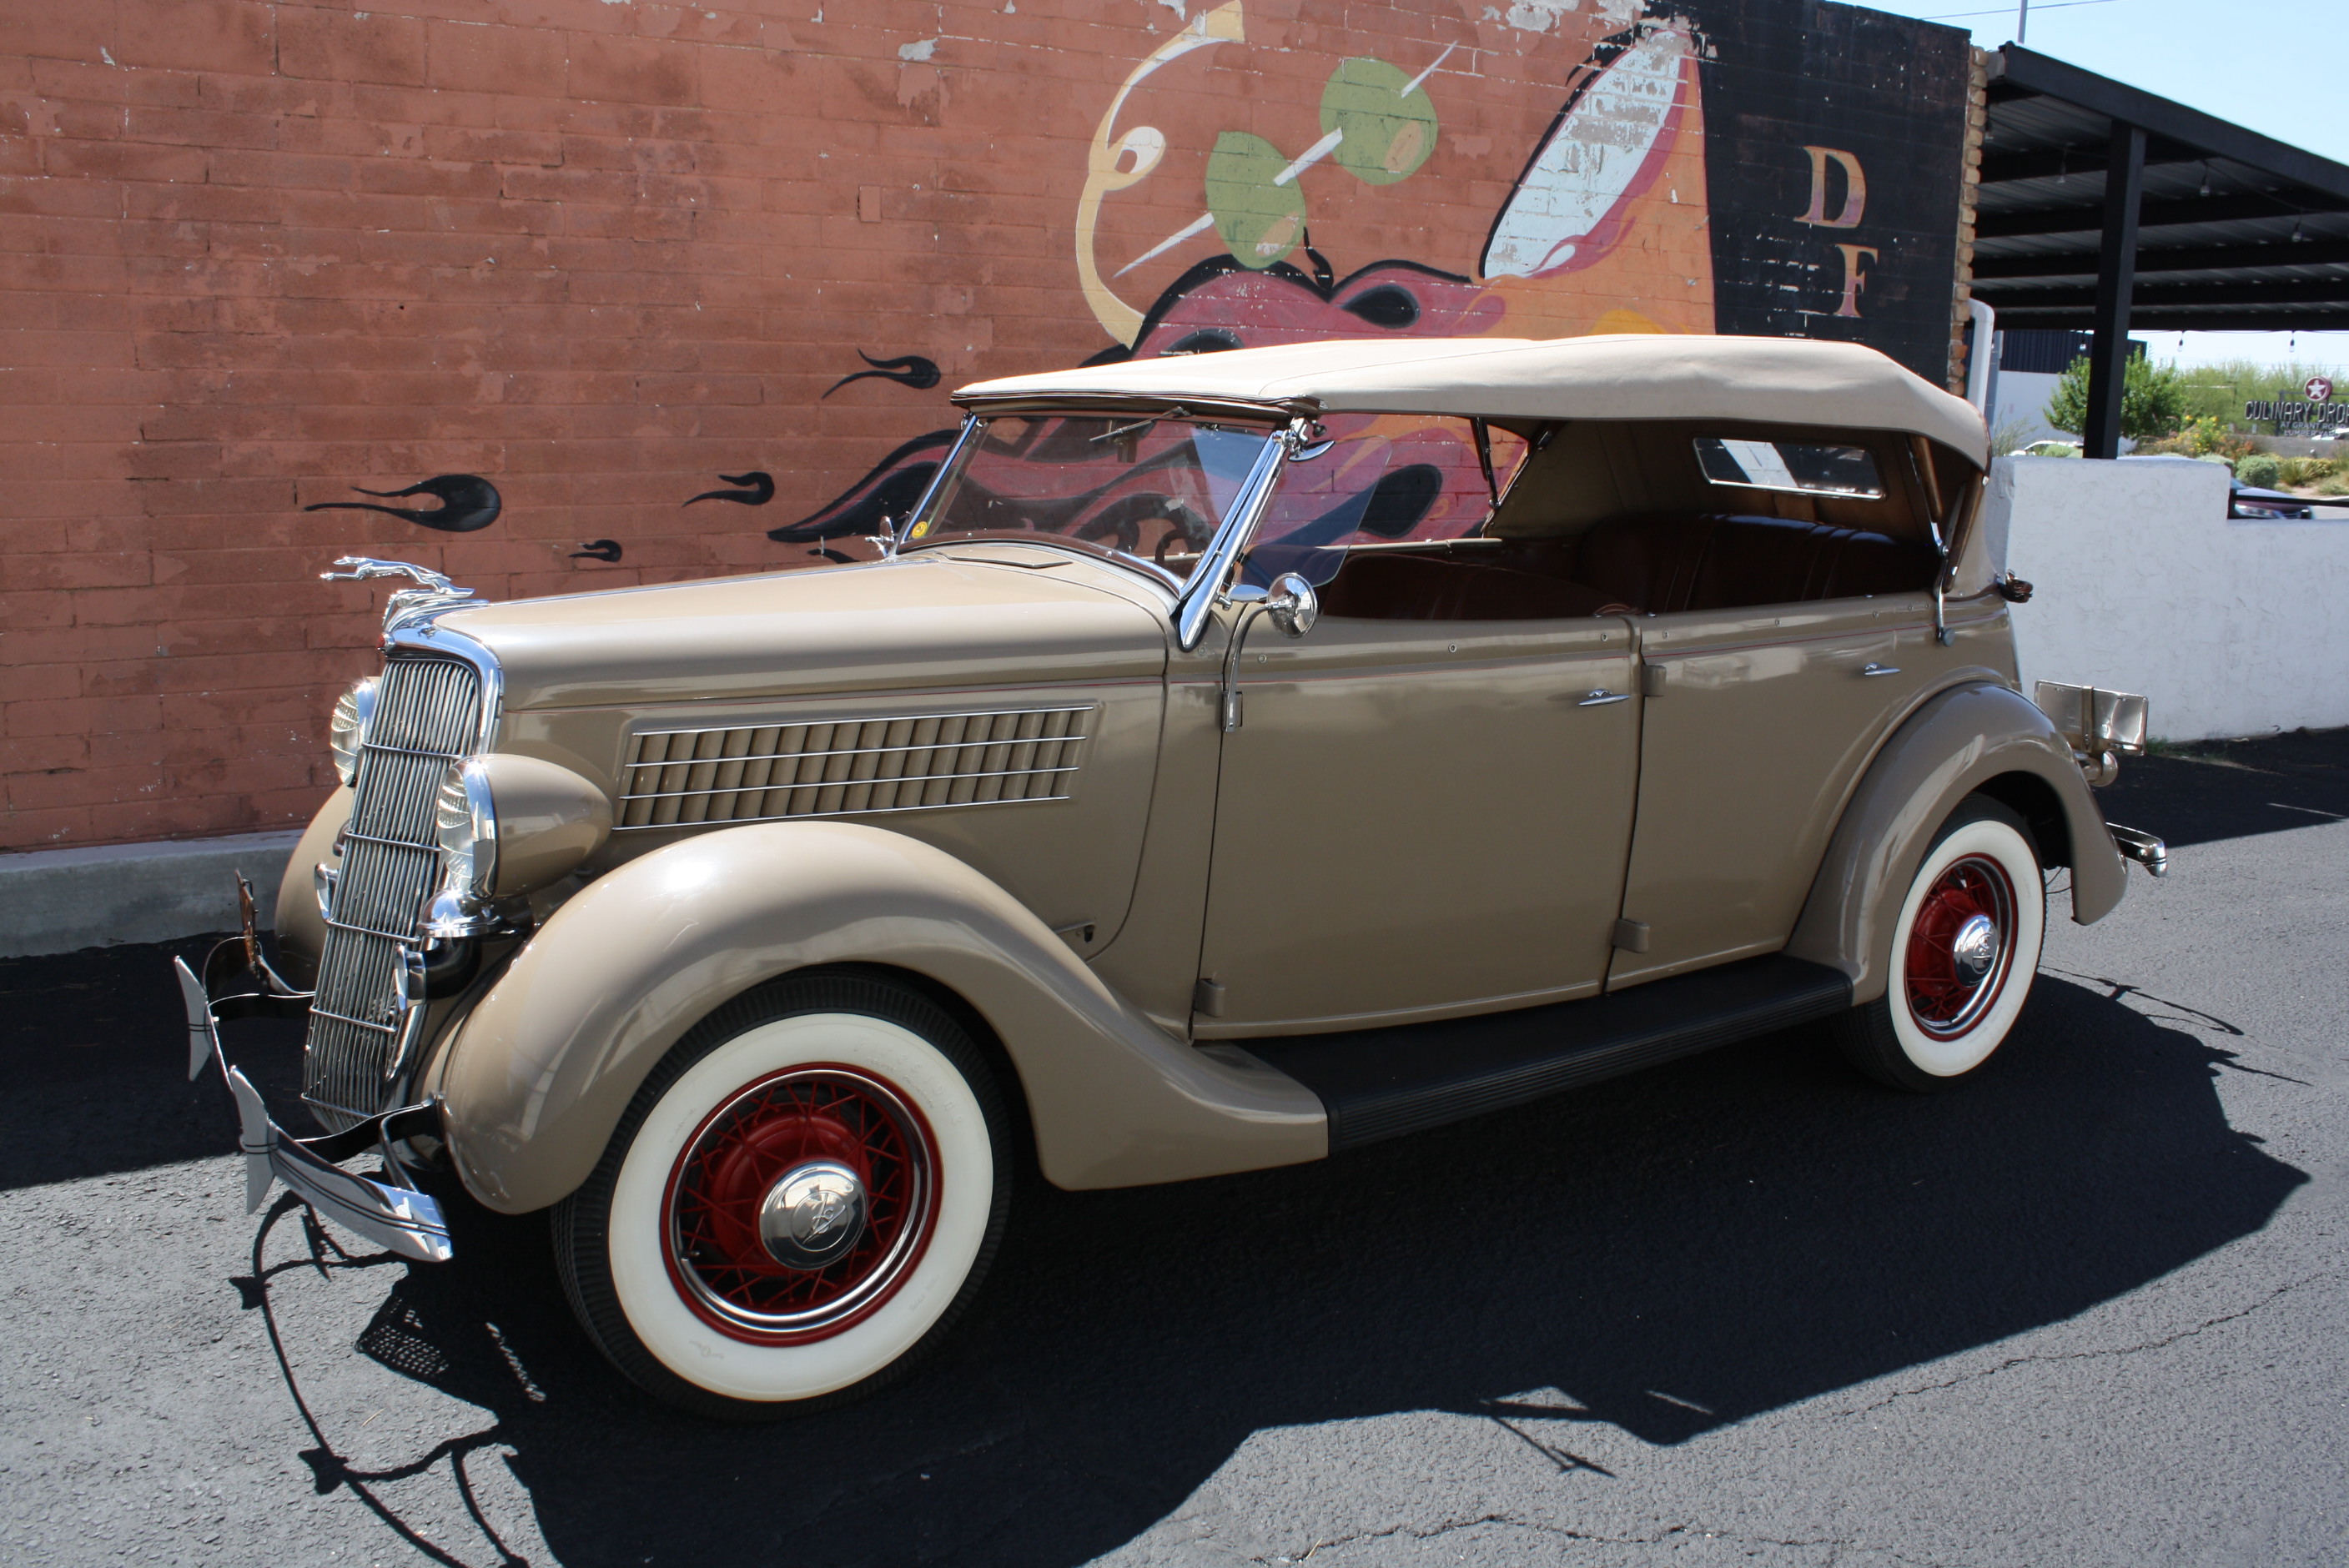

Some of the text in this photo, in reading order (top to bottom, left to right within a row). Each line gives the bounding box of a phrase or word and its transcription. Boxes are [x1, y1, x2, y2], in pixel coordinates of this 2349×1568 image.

[1793, 145, 1866, 229] D
[1834, 244, 1878, 318] F
[2245, 400, 2311, 422] CULINARY
[2292, 421, 2320, 430] GRANT
